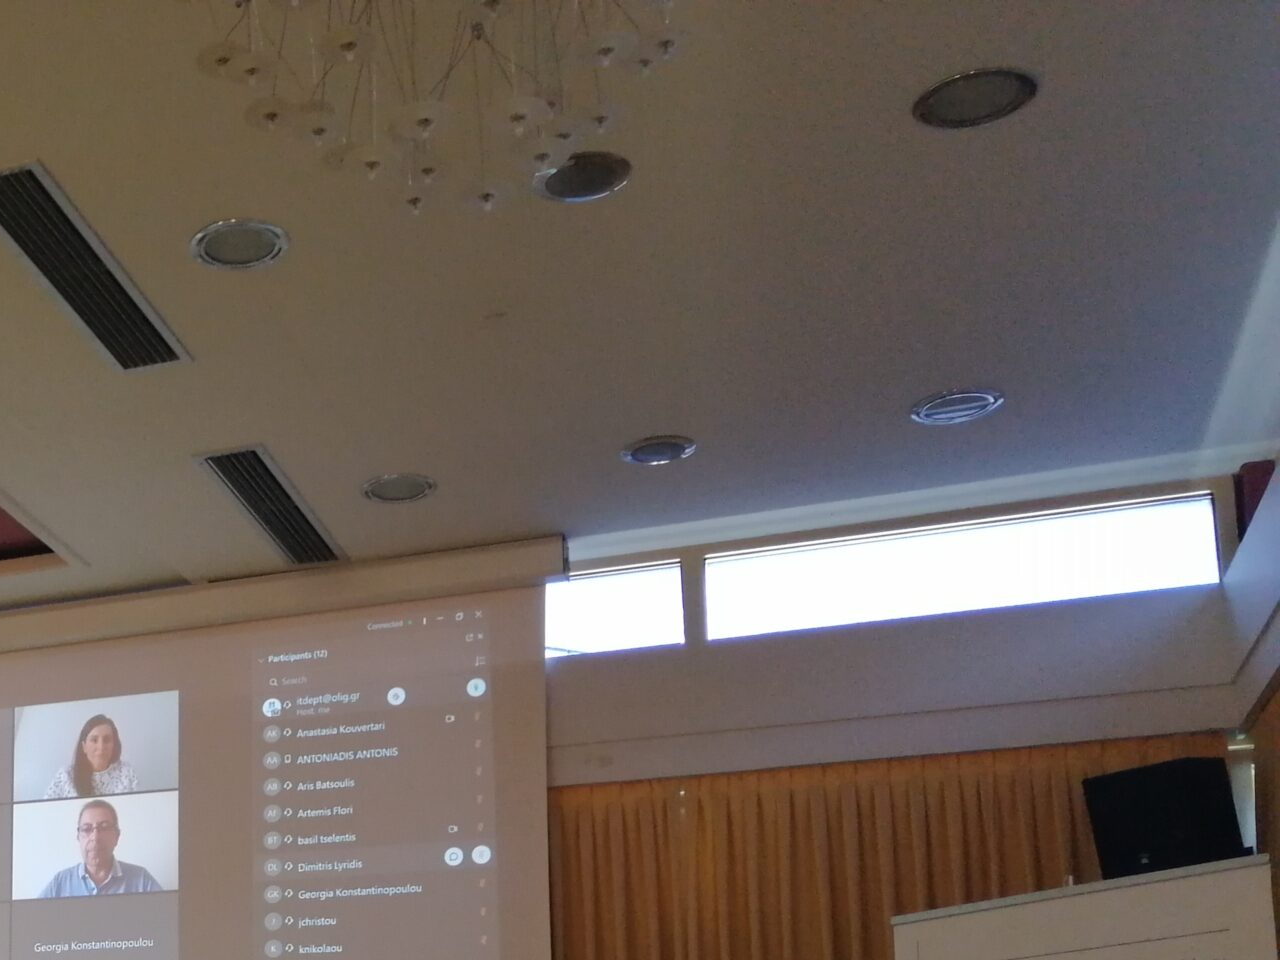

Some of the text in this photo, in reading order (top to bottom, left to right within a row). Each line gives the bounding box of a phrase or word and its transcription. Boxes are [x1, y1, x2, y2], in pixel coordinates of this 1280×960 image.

[268, 651, 312, 664] Participants
[281, 675, 307, 685] Search
[297, 722, 386, 738] Anastasia Kouvertari
[297, 747, 399, 765] ANTONIADIS ANTONIS
[297, 778, 355, 791] Aris Batsoulis
[297, 805, 353, 818] Artemis Flori
[298, 833, 356, 845] basil tselentis
[298, 859, 363, 872] Dimitris Lyridis
[298, 883, 422, 901] Georgia Konstantinopoulou
[298, 916, 337, 928] jchristou
[34, 938, 154, 954] Georgia Konstantinopoulou
[299, 943, 342, 954] knikolaou
